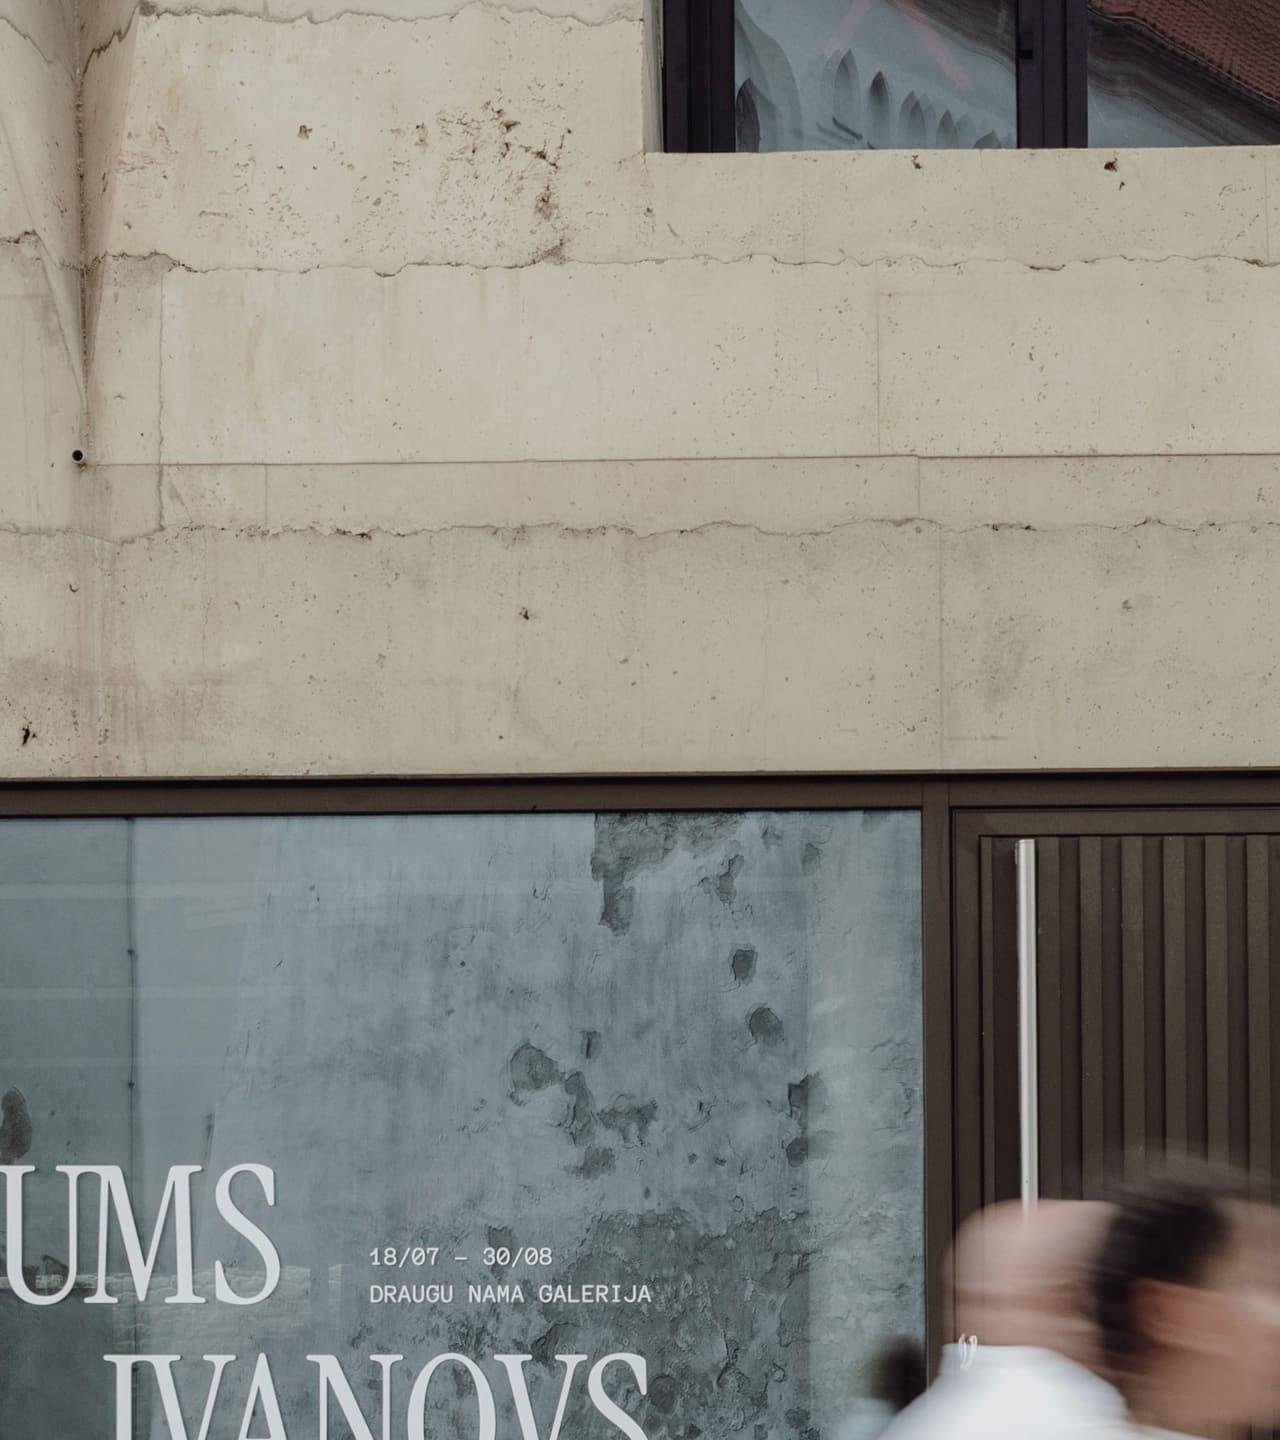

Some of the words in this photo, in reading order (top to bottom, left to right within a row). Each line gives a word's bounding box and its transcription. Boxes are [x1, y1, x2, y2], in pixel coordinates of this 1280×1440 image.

[368, 1247, 440, 1269] 18/07
[482, 1247, 553, 1269] 30/08
[369, 1284, 454, 1304] DRAUGU
[469, 1284, 525, 1304] NAMA
[538, 1284, 652, 1304] GALERIJA
